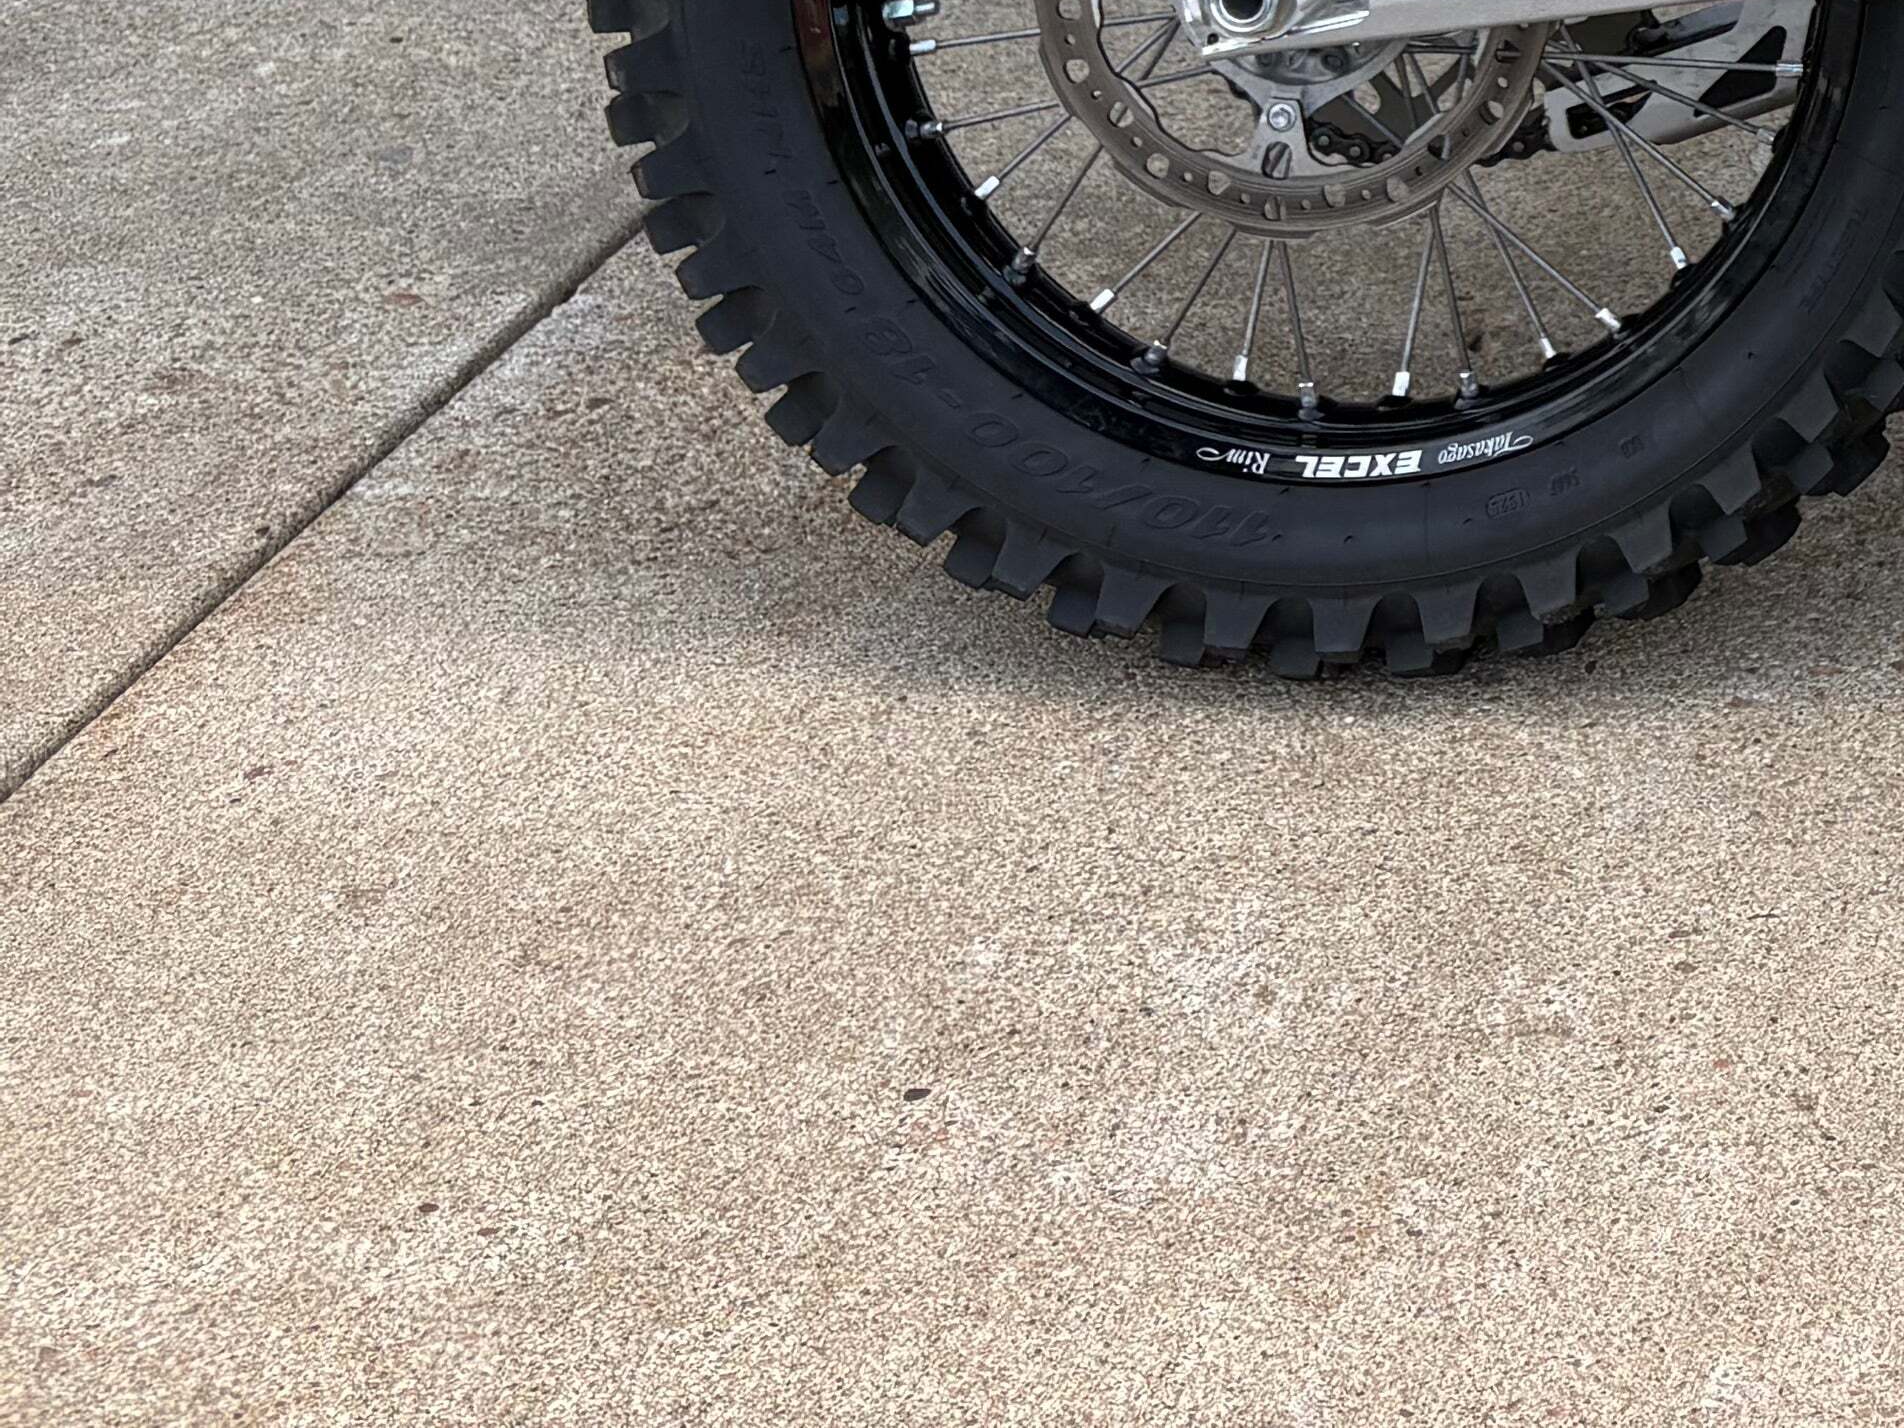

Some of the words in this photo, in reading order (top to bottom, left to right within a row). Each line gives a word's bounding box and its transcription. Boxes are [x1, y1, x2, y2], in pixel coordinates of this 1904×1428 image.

[1195, 446, 1271, 475] Rim
[1437, 430, 1536, 466] Takasago
[1295, 449, 1423, 478] EXCEL
